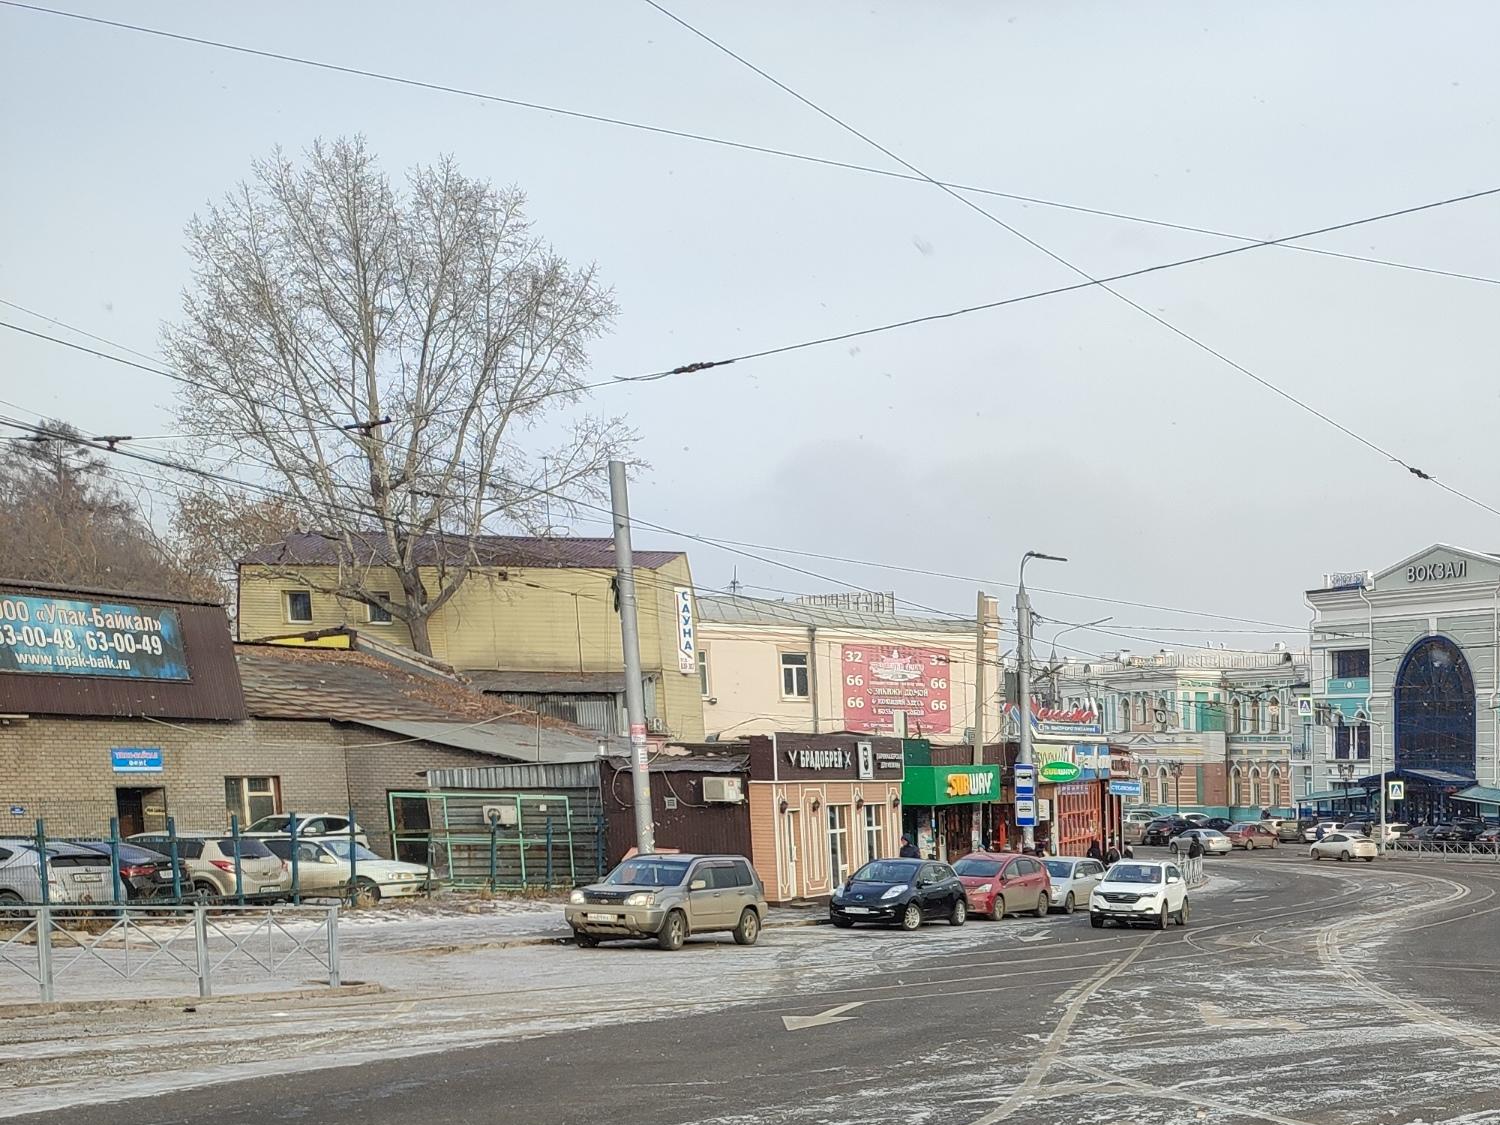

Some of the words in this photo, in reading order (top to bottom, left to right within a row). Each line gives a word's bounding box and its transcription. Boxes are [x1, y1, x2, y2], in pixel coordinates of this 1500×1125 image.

[1407, 560, 1466, 582] ВОКЗАЛ
[36, 604, 161, 632] «Упак-Байкал»
[681, 591, 692, 650] САУНА
[86, 631, 162, 656] 63-00-49
[15, 652, 131, 670] www.upak-baik.ru
[845, 651, 862, 662] 32
[930, 655, 946, 666] 32
[847, 675, 864, 686] 66
[931, 678, 947, 689] 66
[847, 697, 864, 708] 66
[931, 700, 947, 711] 66
[800, 748, 843, 771] БРАДОБРЕЙ
[1043, 769, 1078, 777] SUBWAY
[946, 772, 993, 796] SUBWAY
